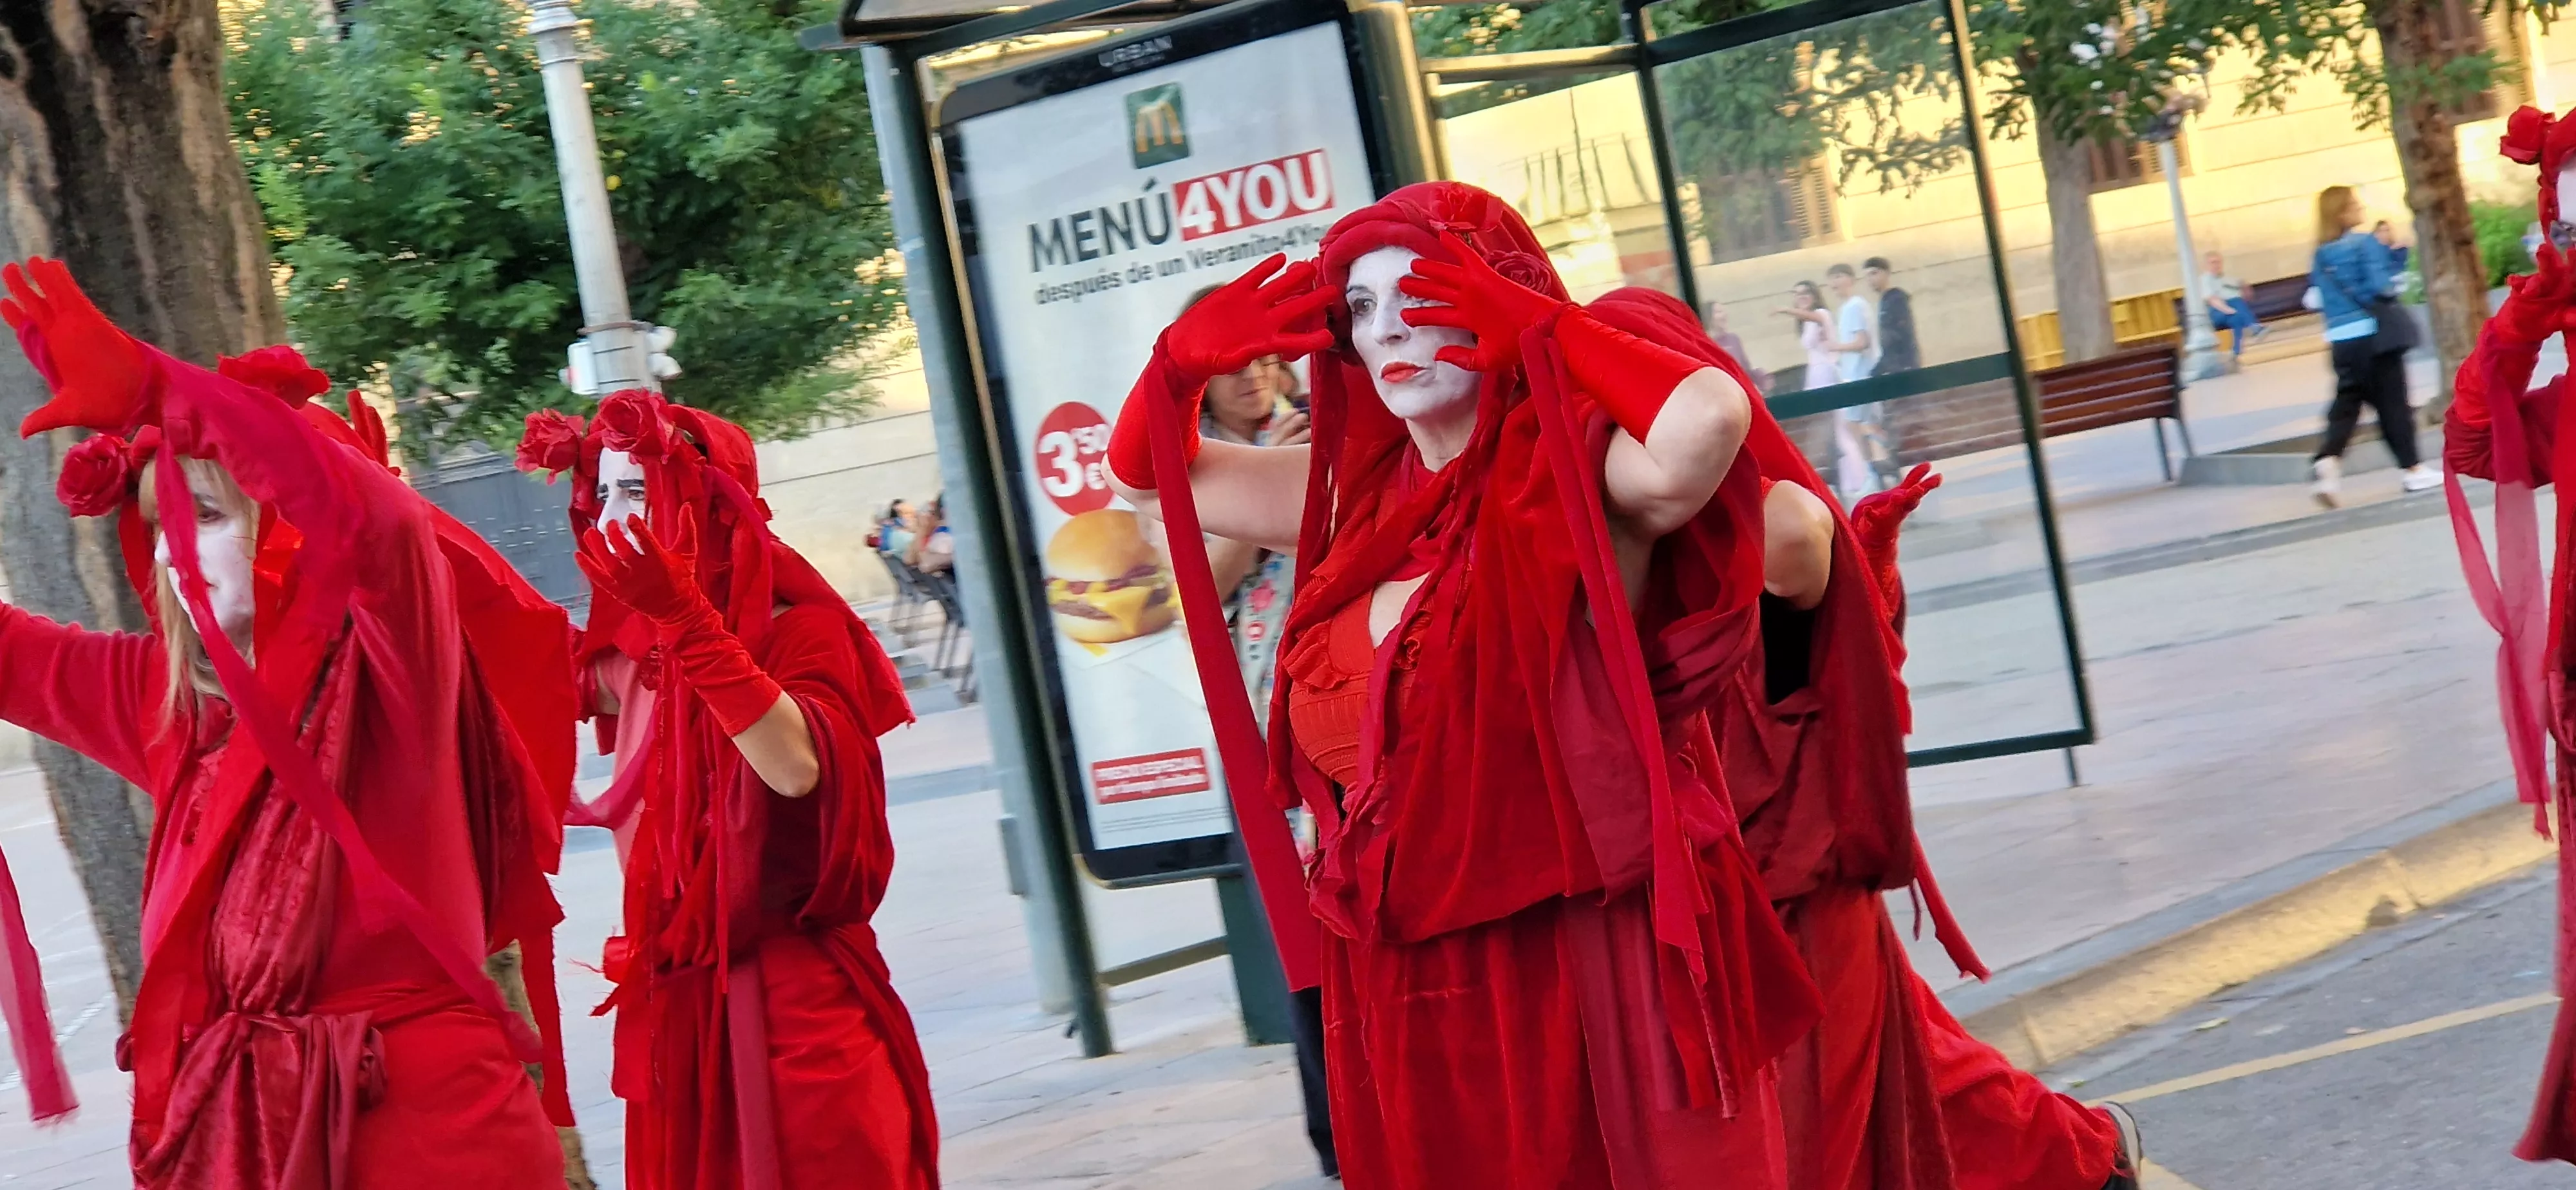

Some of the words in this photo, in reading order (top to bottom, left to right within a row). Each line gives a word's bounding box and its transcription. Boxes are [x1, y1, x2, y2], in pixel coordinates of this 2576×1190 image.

[1035, 267, 1123, 305] después
[1126, 261, 1154, 283] de
[1156, 257, 1186, 277] un
[1187, 222, 1331, 269] Veranito4Yo
